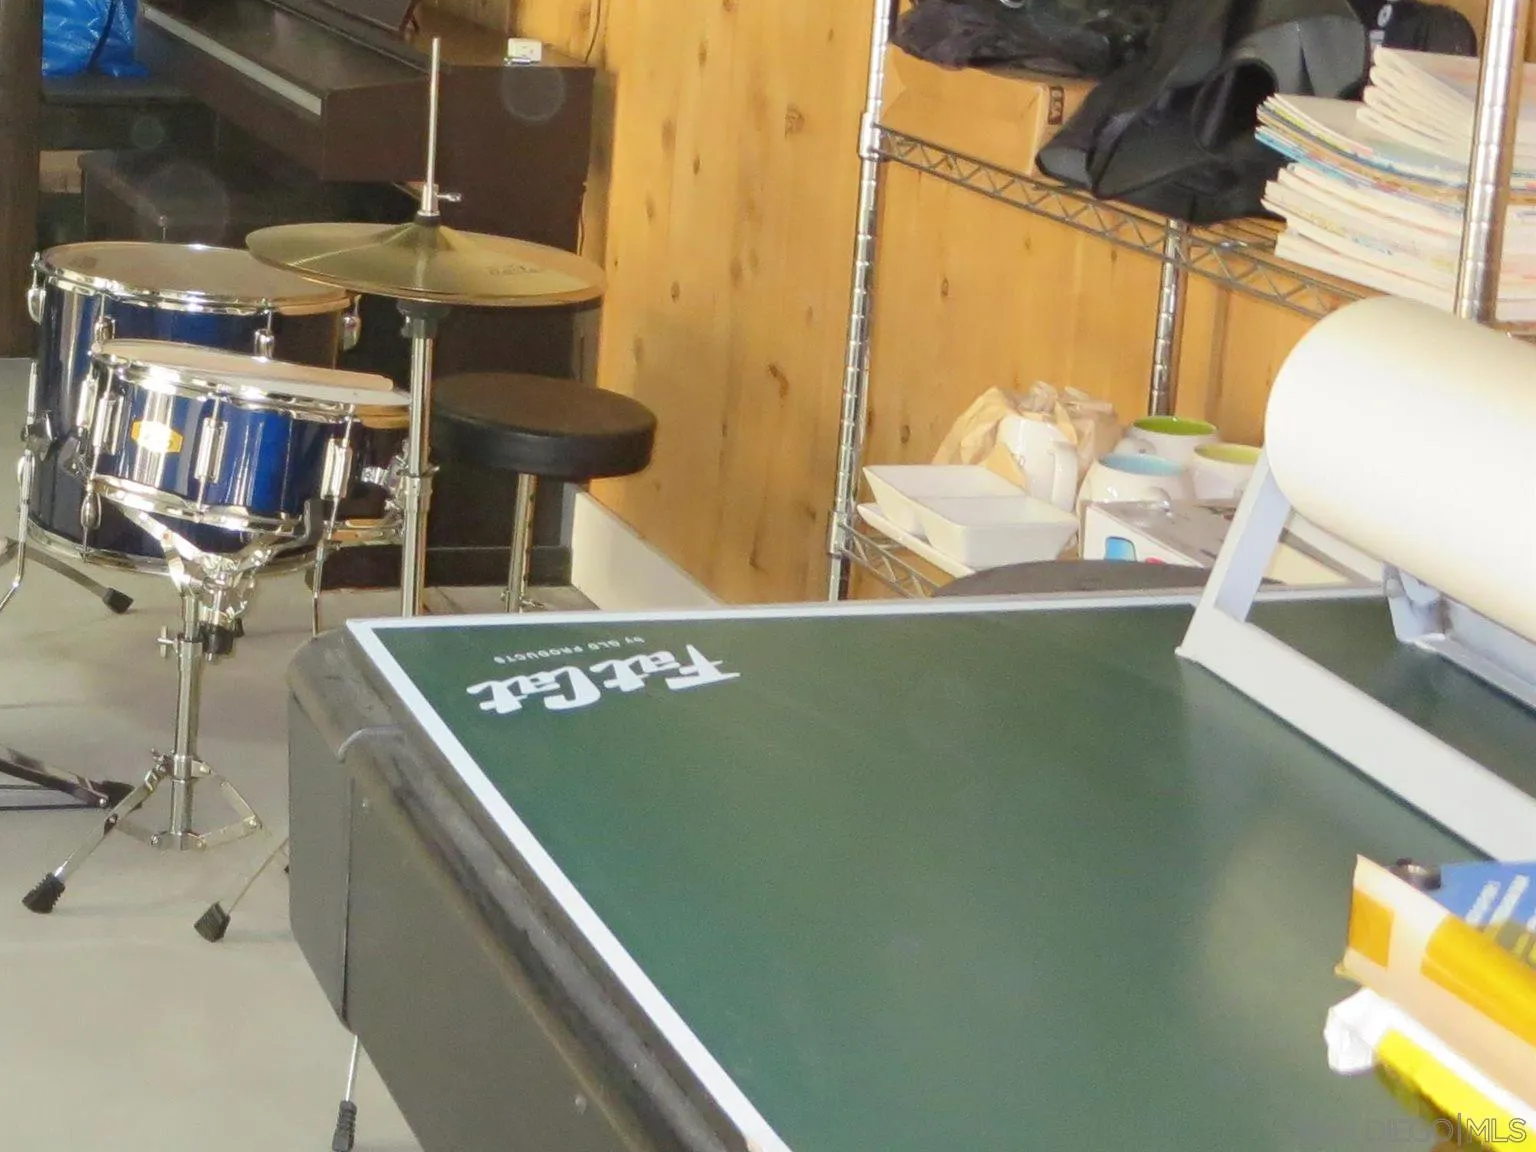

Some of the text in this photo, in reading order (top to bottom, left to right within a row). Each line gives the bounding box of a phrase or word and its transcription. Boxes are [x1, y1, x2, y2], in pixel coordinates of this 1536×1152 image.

[493, 644, 584, 665] PRODUCTS
[465, 643, 742, 715] Fat Cat
